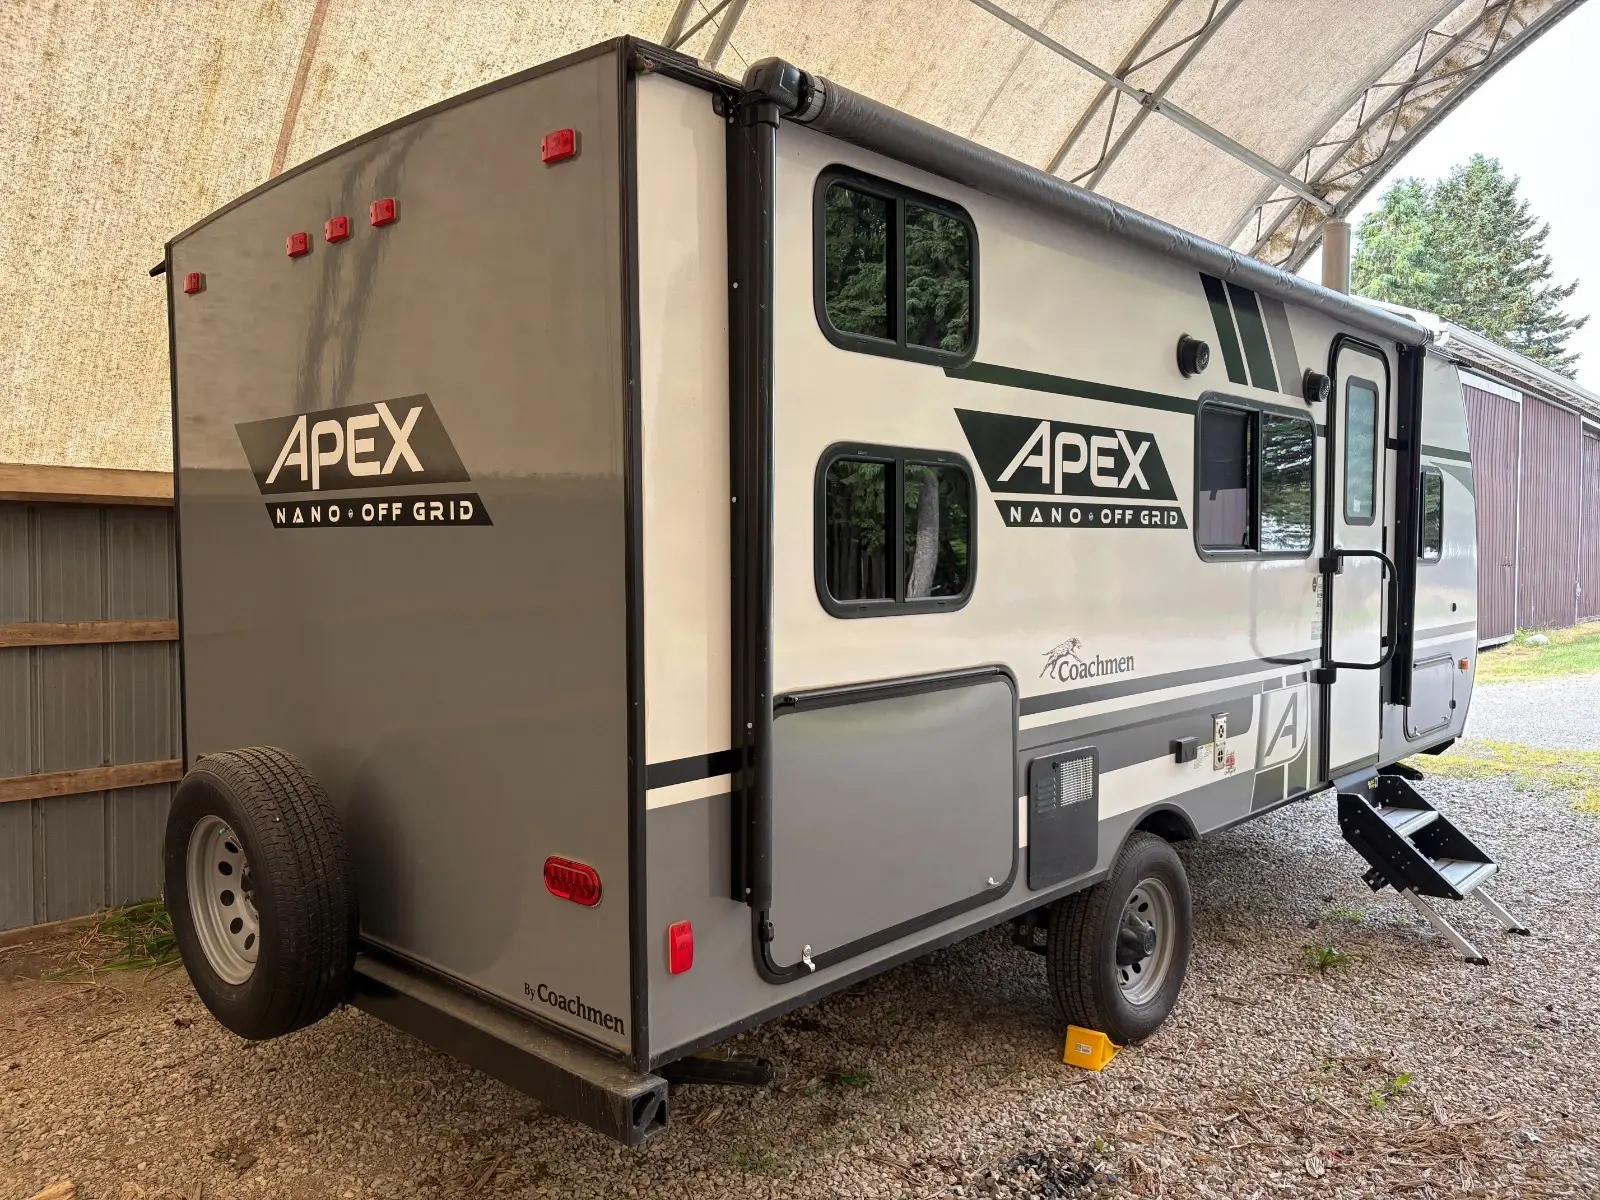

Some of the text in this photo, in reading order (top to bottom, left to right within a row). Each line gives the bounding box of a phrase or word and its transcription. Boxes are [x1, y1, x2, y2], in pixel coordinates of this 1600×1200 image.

[265, 402, 424, 490] APEX
[997, 420, 1151, 494] APEX
[276, 500, 474, 523] NANO OFF GRID
[1010, 506, 1179, 525] NANO OFF GRID
[1058, 654, 1135, 682] Coachmen
[524, 982, 625, 1036] By Coachmen
